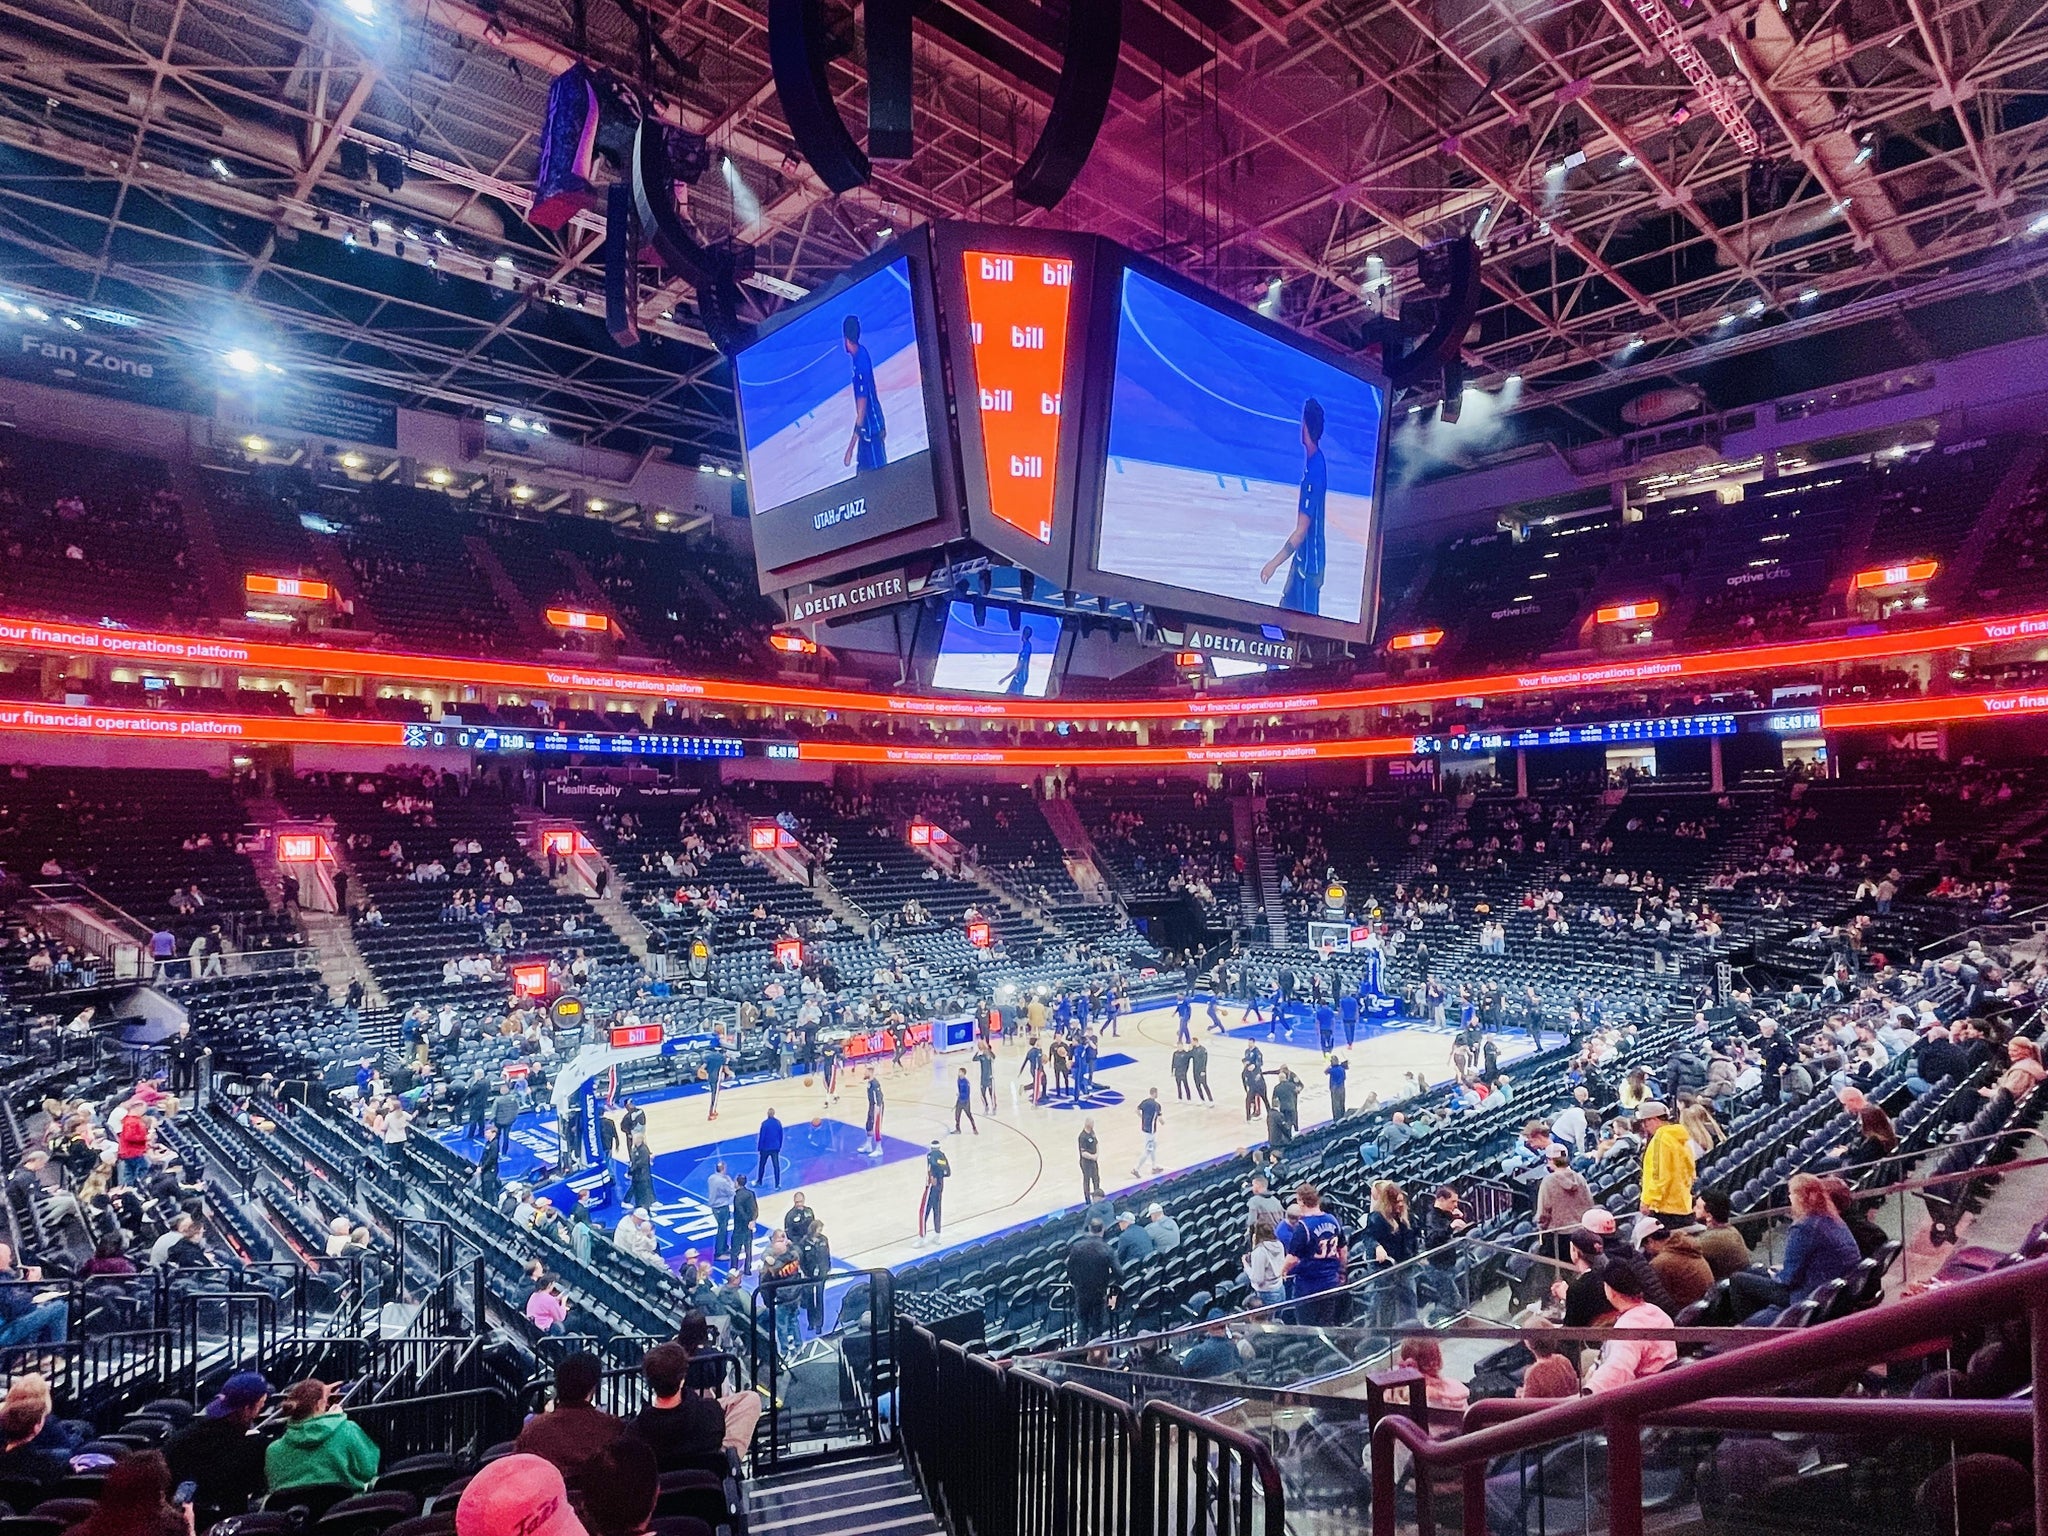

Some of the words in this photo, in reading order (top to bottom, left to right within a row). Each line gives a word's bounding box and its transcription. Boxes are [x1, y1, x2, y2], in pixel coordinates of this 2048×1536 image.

[981, 258, 1013, 281] bill
[1012, 326, 1043, 349] bill
[22, 334, 77, 363] Fan
[84, 348, 153, 378] Zone
[981, 389, 1012, 412] bill
[1011, 455, 1042, 478] bill
[814, 509, 836, 530] UTAH
[845, 498, 867, 520] JAZZ
[277, 579, 299, 594] bill
[1727, 571, 1764, 586] optive
[1886, 567, 1907, 583] bill
[805, 592, 848, 616] DELTA
[850, 577, 902, 604] CENTER
[1491, 607, 1520, 620] optive
[1985, 622, 2016, 637] Your
[31, 627, 99, 647] financial
[102, 637, 184, 655] operations
[187, 643, 248, 661] platform
[1203, 634, 1246, 654] DELTA
[1250, 640, 1294, 661] CENTER
[546, 671, 570, 684] Your
[572, 673, 613, 688] financial
[614, 677, 666, 693] operations
[666, 680, 704, 695] platform
[1518, 676, 1539, 687] Your
[1541, 672, 1581, 685] financial
[1582, 668, 1635, 682] operations
[1636, 662, 1682, 678] platform
[1188, 703, 1206, 712] Your
[1208, 702, 1240, 711] financial
[1241, 700, 1283, 711] operations
[1284, 698, 1318, 708] platform
[1983, 698, 2015, 712] Your
[23, 710, 92, 729] financial
[95, 717, 178, 733] operations
[181, 721, 242, 736] platform
[1774, 716, 1802, 731] 06:49
[1804, 714, 1821, 728] PM
[434, 731, 443, 746] 0
[459, 732, 468, 746] 0
[1187, 751, 1204, 759] Your
[1206, 750, 1239, 759] financial
[1240, 748, 1281, 759] operations
[1283, 747, 1316, 757] platform
[557, 784, 622, 798] HealthEquity
[285, 840, 311, 856] bill
[628, 1030, 645, 1043] bill
[586, 1094, 595, 1119] FIRST
[587, 1118, 600, 1157] AMERICA
[1314, 1236, 1340, 1259] 32
